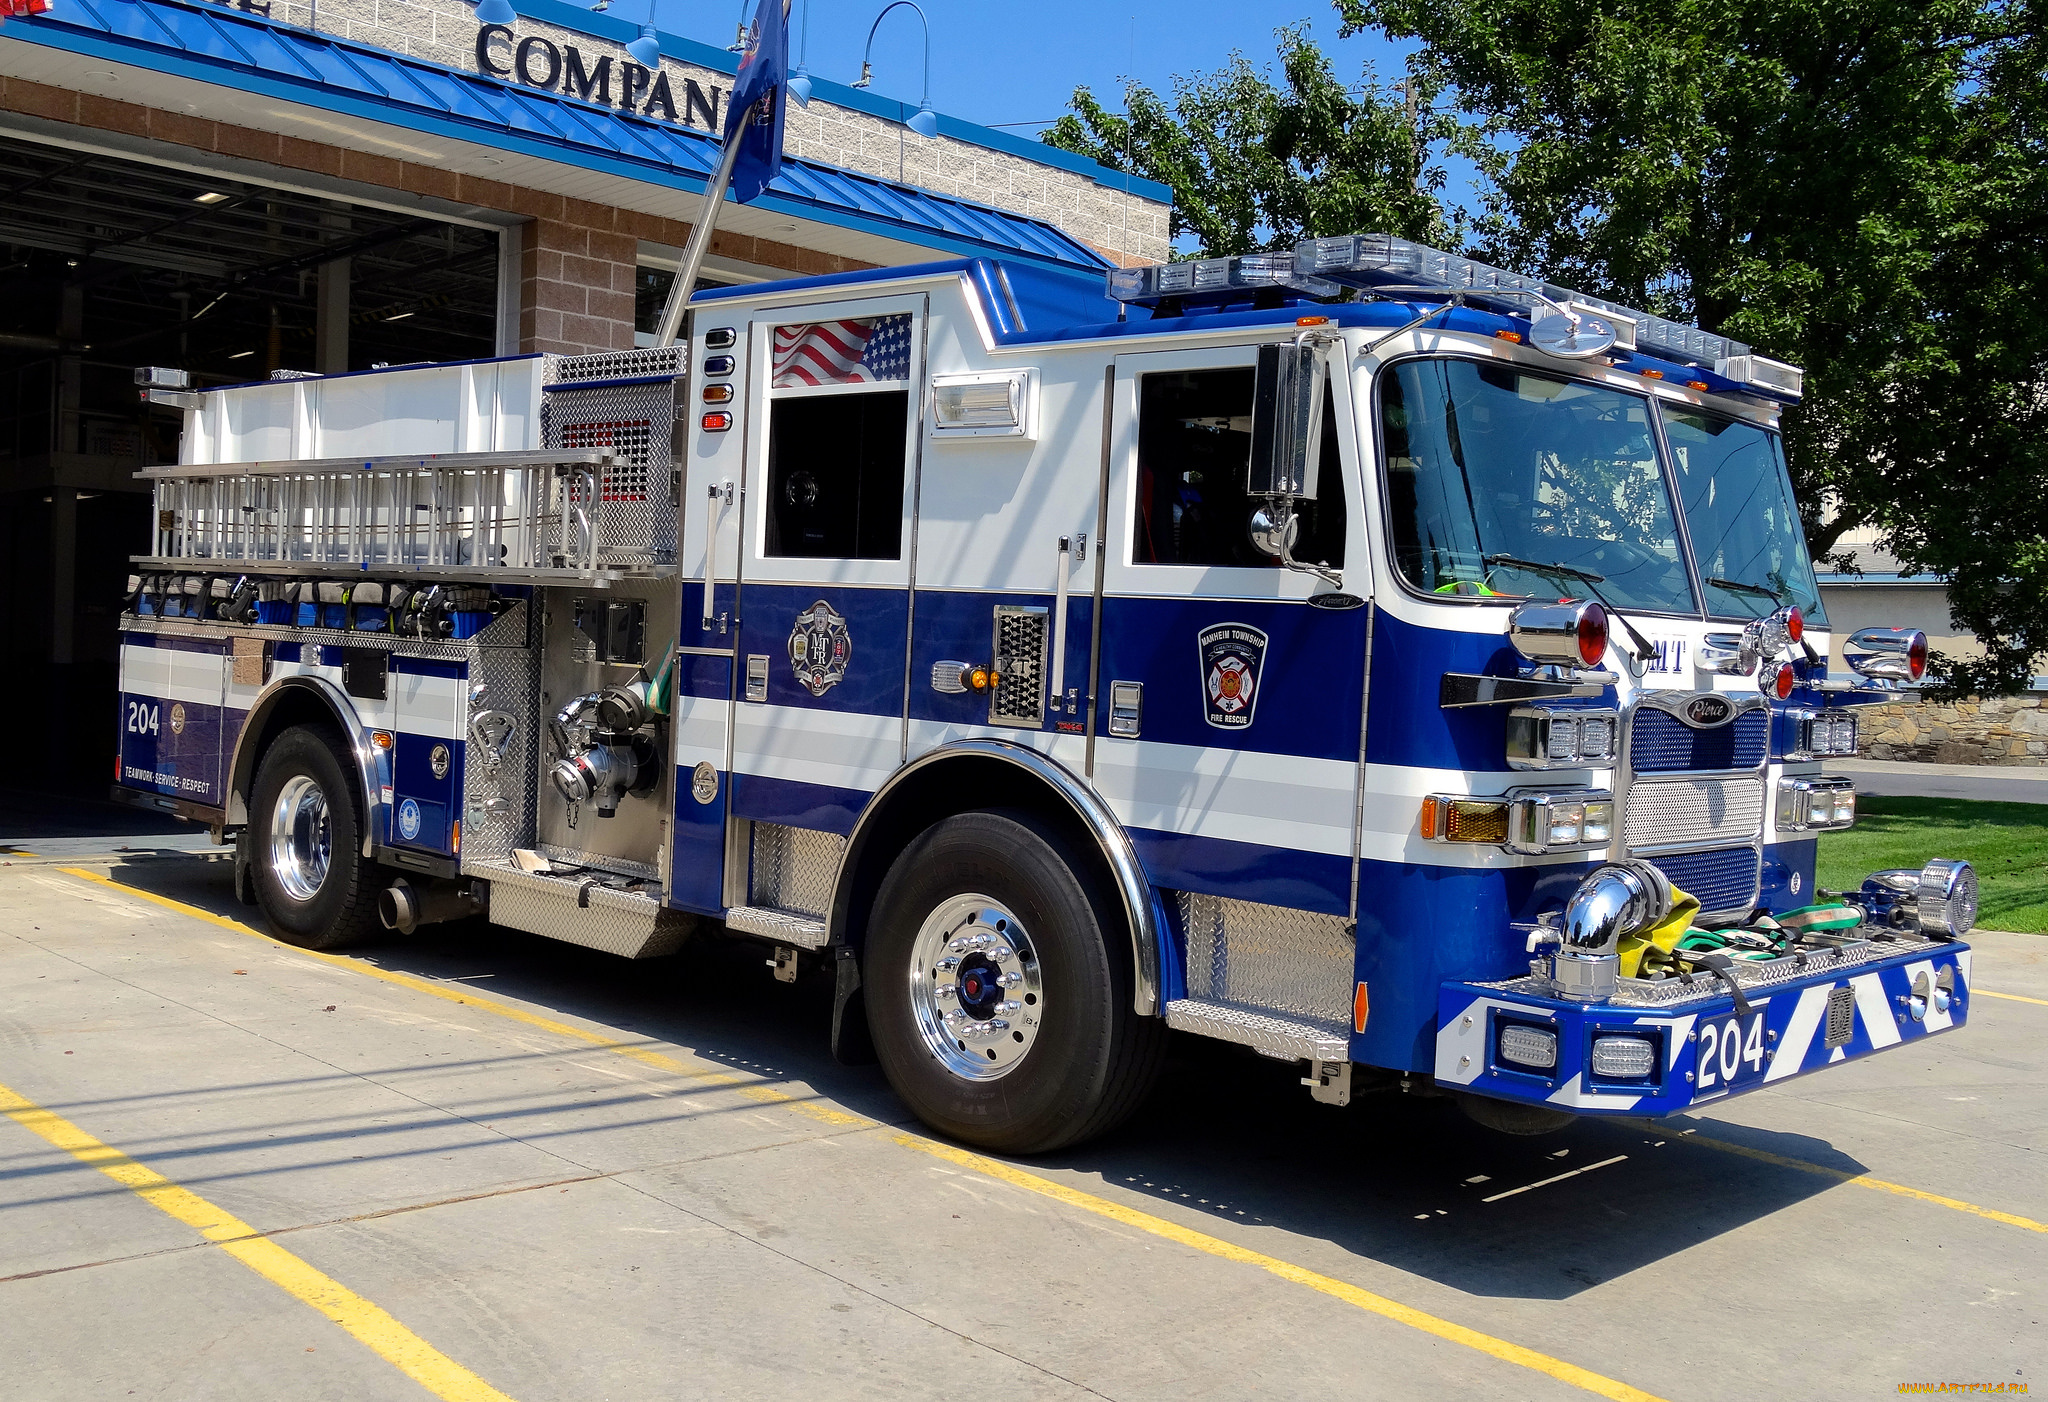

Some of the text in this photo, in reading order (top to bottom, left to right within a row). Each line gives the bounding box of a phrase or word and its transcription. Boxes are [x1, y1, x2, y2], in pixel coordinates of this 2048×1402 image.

[475, 24, 732, 130] COMPAN
[1201, 630, 1265, 648] MANHEIM TOWNSHIP
[128, 701, 159, 736] 204
[1210, 713, 1248, 724] FIRE RESCUE
[1692, 700, 1724, 719] Pierce
[1698, 1012, 1764, 1089] 204
